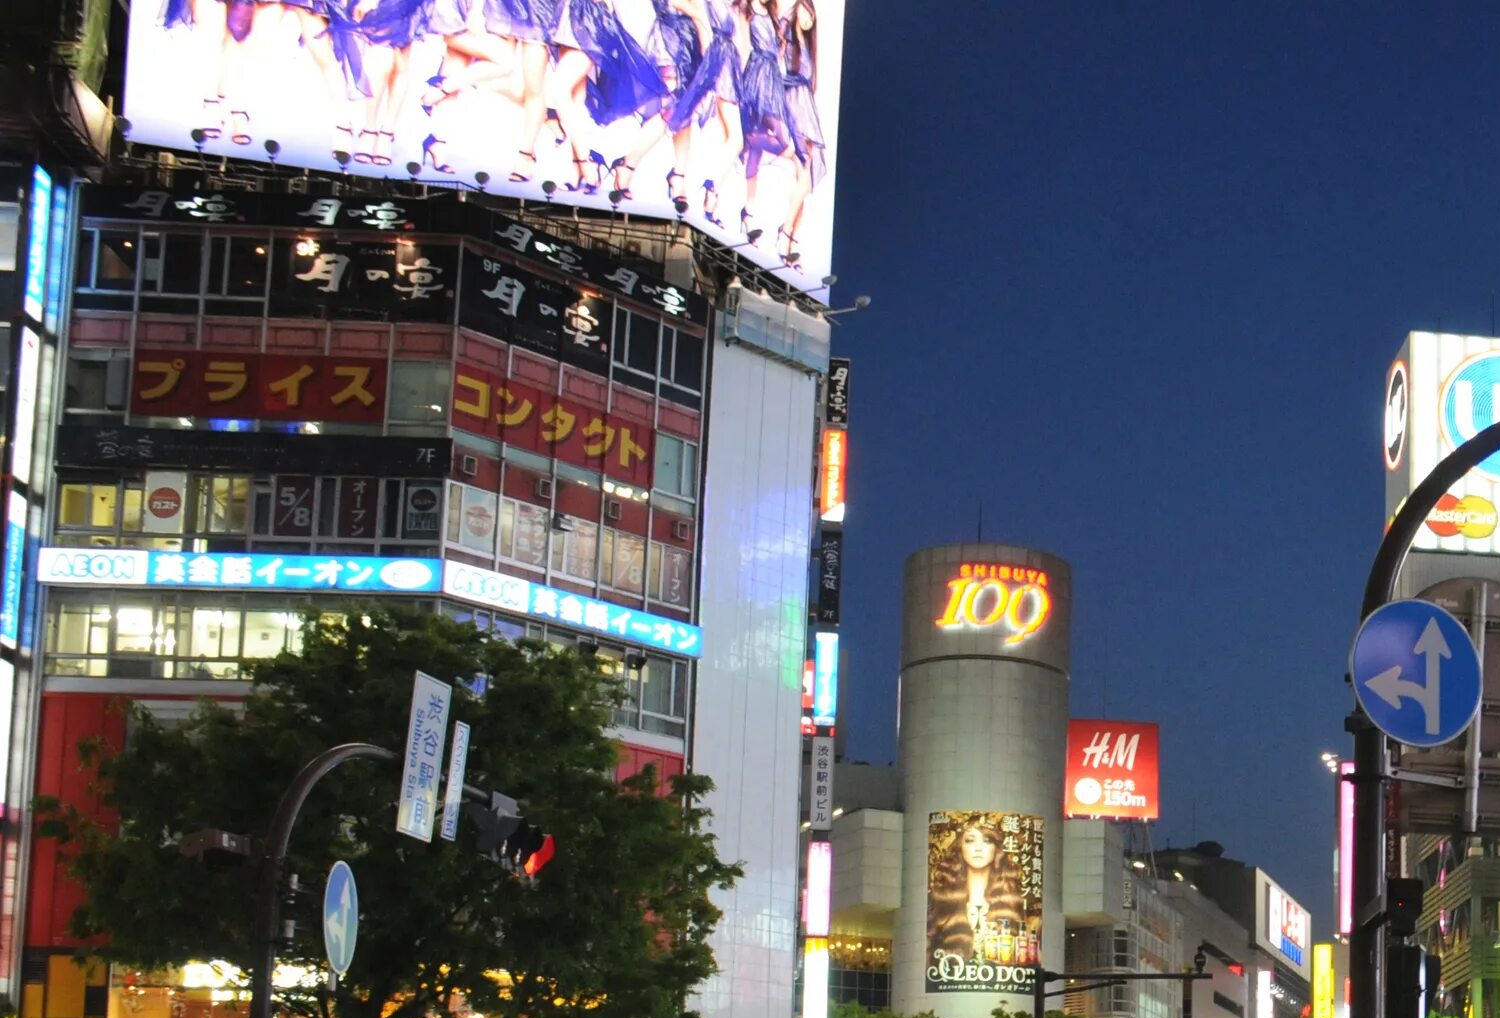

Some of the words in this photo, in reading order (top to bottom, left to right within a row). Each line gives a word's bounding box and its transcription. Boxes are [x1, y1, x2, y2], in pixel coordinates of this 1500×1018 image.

[297, 198, 406, 230] 月の宴
[295, 253, 444, 300] 月の宴
[483, 260, 501, 274] 9F
[482, 275, 599, 347] 月の宴
[138, 358, 375, 406] プライス
[454, 374, 647, 468] コンタクト
[417, 448, 435, 463] 7F
[152, 500, 178, 510] ガスト
[280, 487, 312, 526] 5/8
[351, 479, 365, 537] オープン
[1427, 507, 1496, 525] MasterCard
[51, 554, 135, 578] AEON
[155, 553, 371, 586] 英会話イーオン
[960, 563, 1048, 586] SHIBUYA
[534, 588, 697, 650] 英会話イーオン
[823, 609, 834, 619] 7F
[934, 576, 1050, 648] 109
[409, 709, 425, 769] Shibuya
[1082, 731, 1140, 771] H&M
[816, 744, 828, 823] 渋谷駅前ビル
[1103, 779, 1136, 791] この先
[1104, 790, 1147, 807] 150m
[1002, 815, 1020, 863] 誕生。
[1020, 818, 1032, 911] オイルシャンプー
